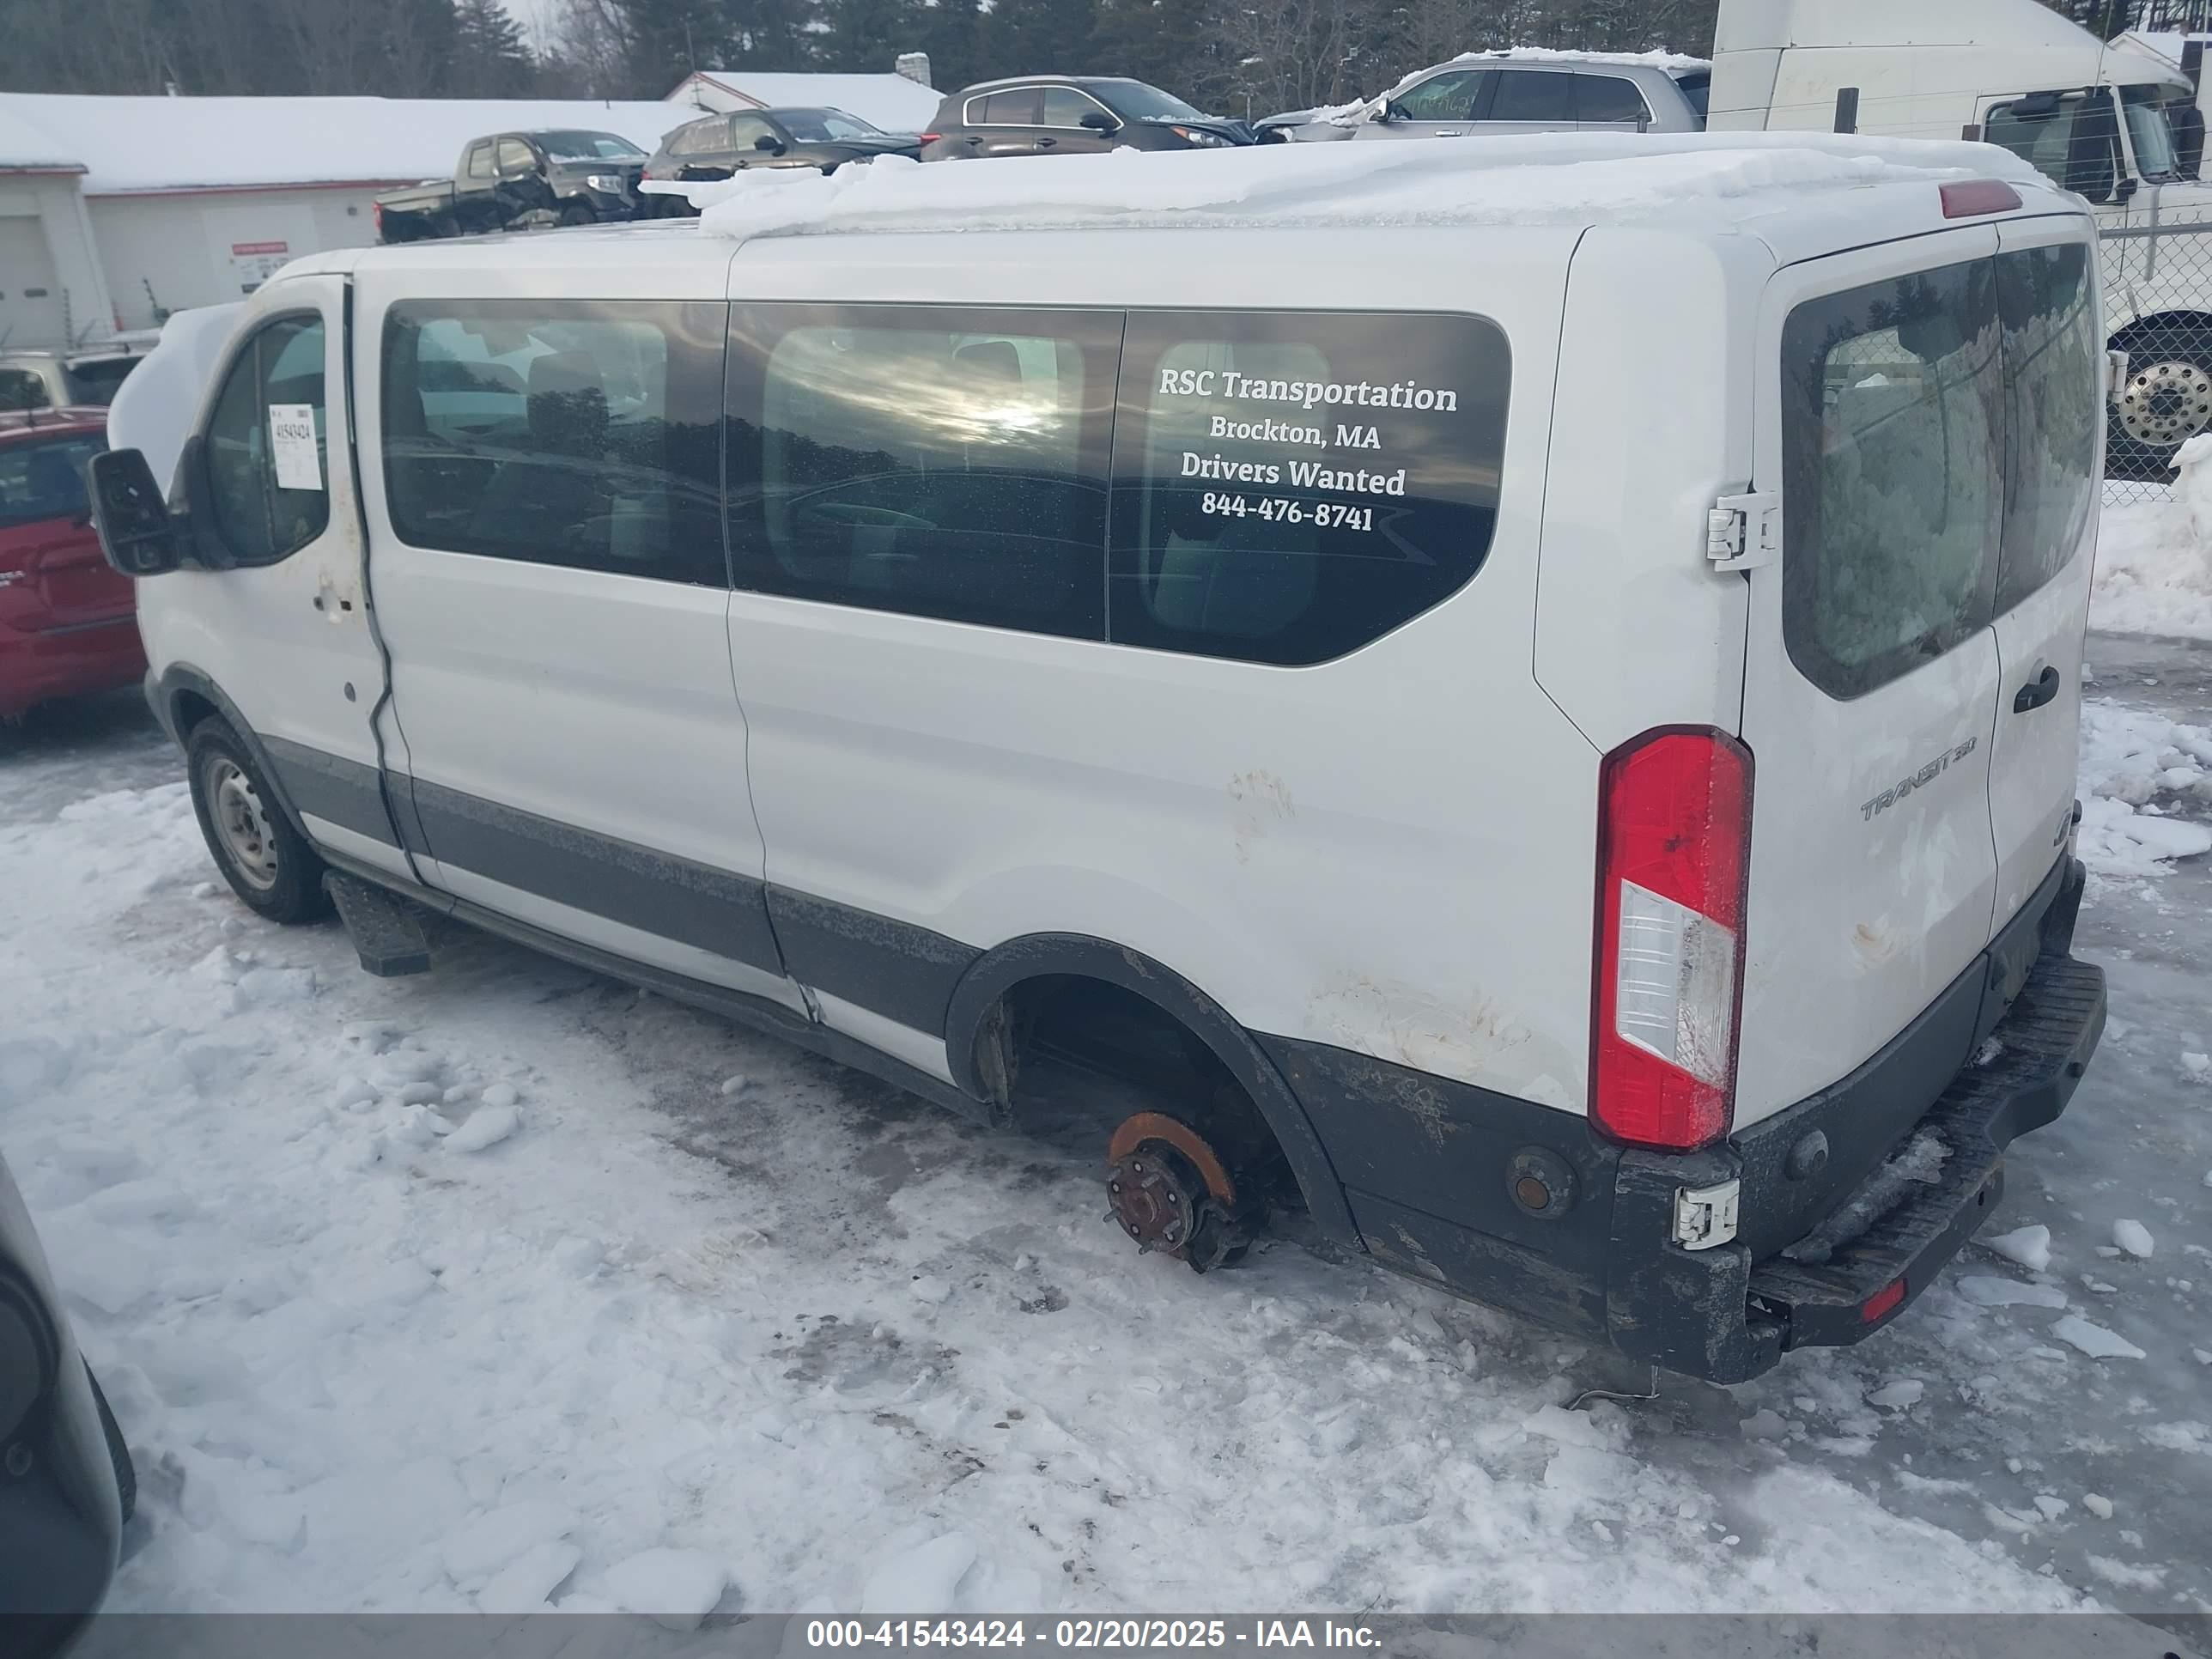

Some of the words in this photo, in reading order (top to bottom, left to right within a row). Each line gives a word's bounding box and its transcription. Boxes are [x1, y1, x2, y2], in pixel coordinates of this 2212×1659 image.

[1159, 369, 1214, 396] RSC
[1222, 372, 1457, 411] Transportation
[1210, 416, 1328, 449] Brockton,
[1334, 424, 1381, 449] MA
[1181, 453, 1279, 485] Drivers
[1289, 461, 1406, 495] Wanted
[1202, 493, 1372, 532] 844-476-8741
[1861, 749, 1952, 821] TRANSIT
